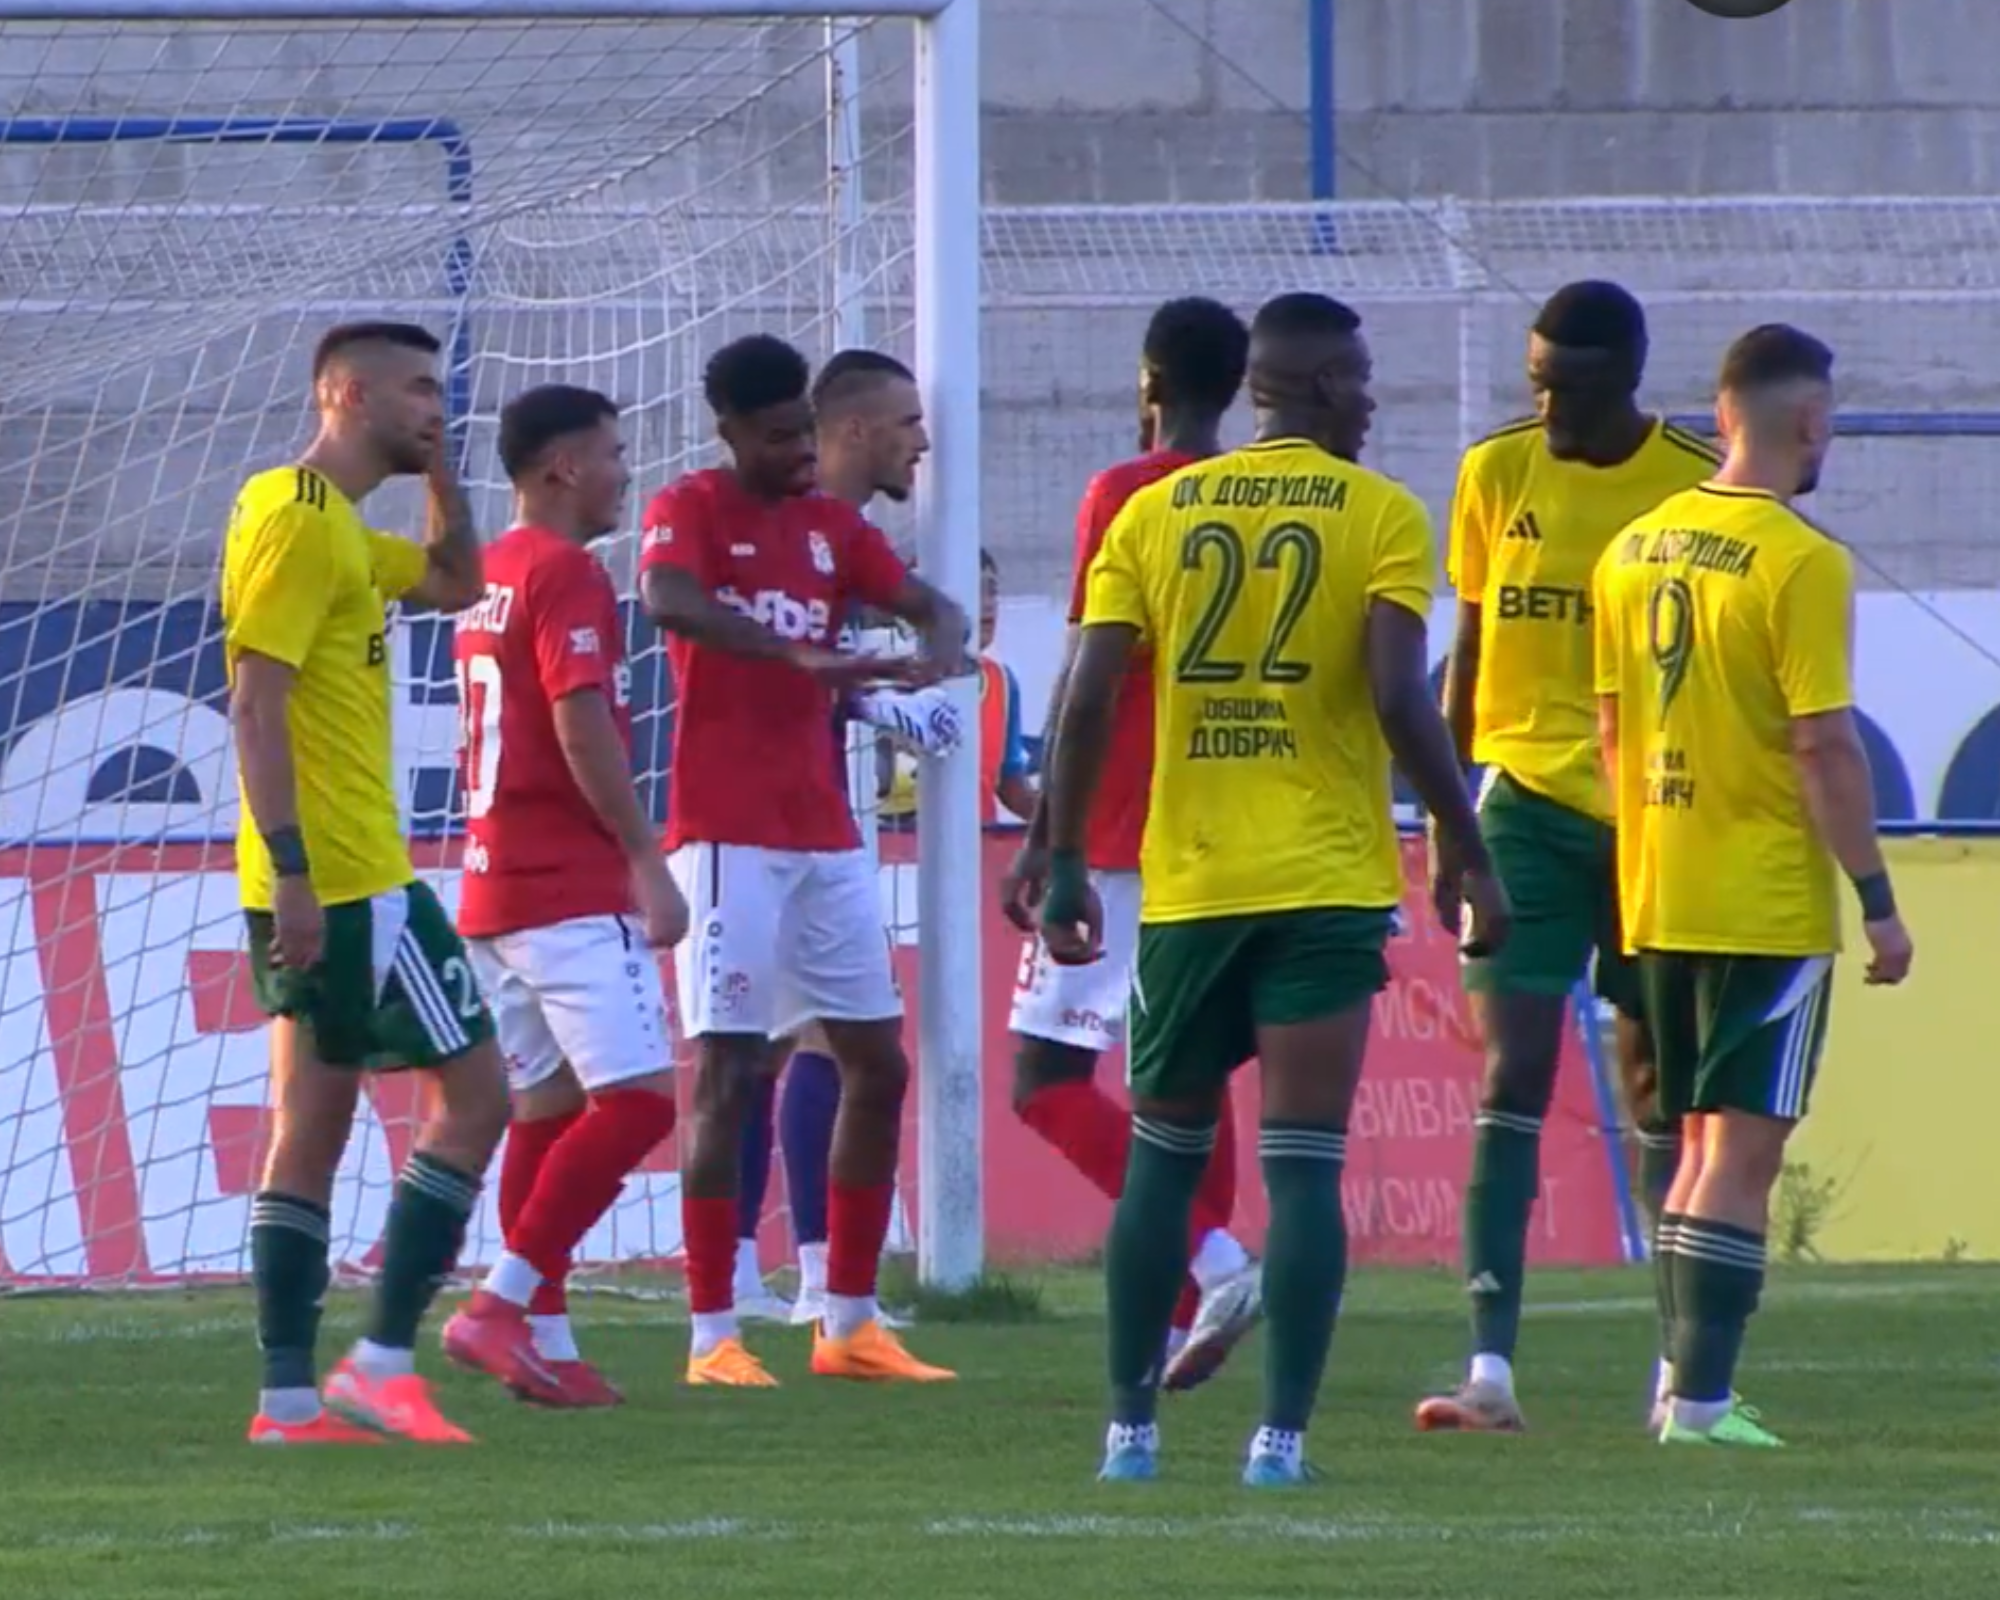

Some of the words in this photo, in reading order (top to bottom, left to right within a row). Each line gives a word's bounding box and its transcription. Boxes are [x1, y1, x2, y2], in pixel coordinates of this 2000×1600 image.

[1211, 474, 1348, 512] ДОБРУДЖА
[1177, 521, 1322, 684] 22
[1651, 578, 1695, 732] 9
[1188, 727, 1298, 759] ДОБРИЧ
